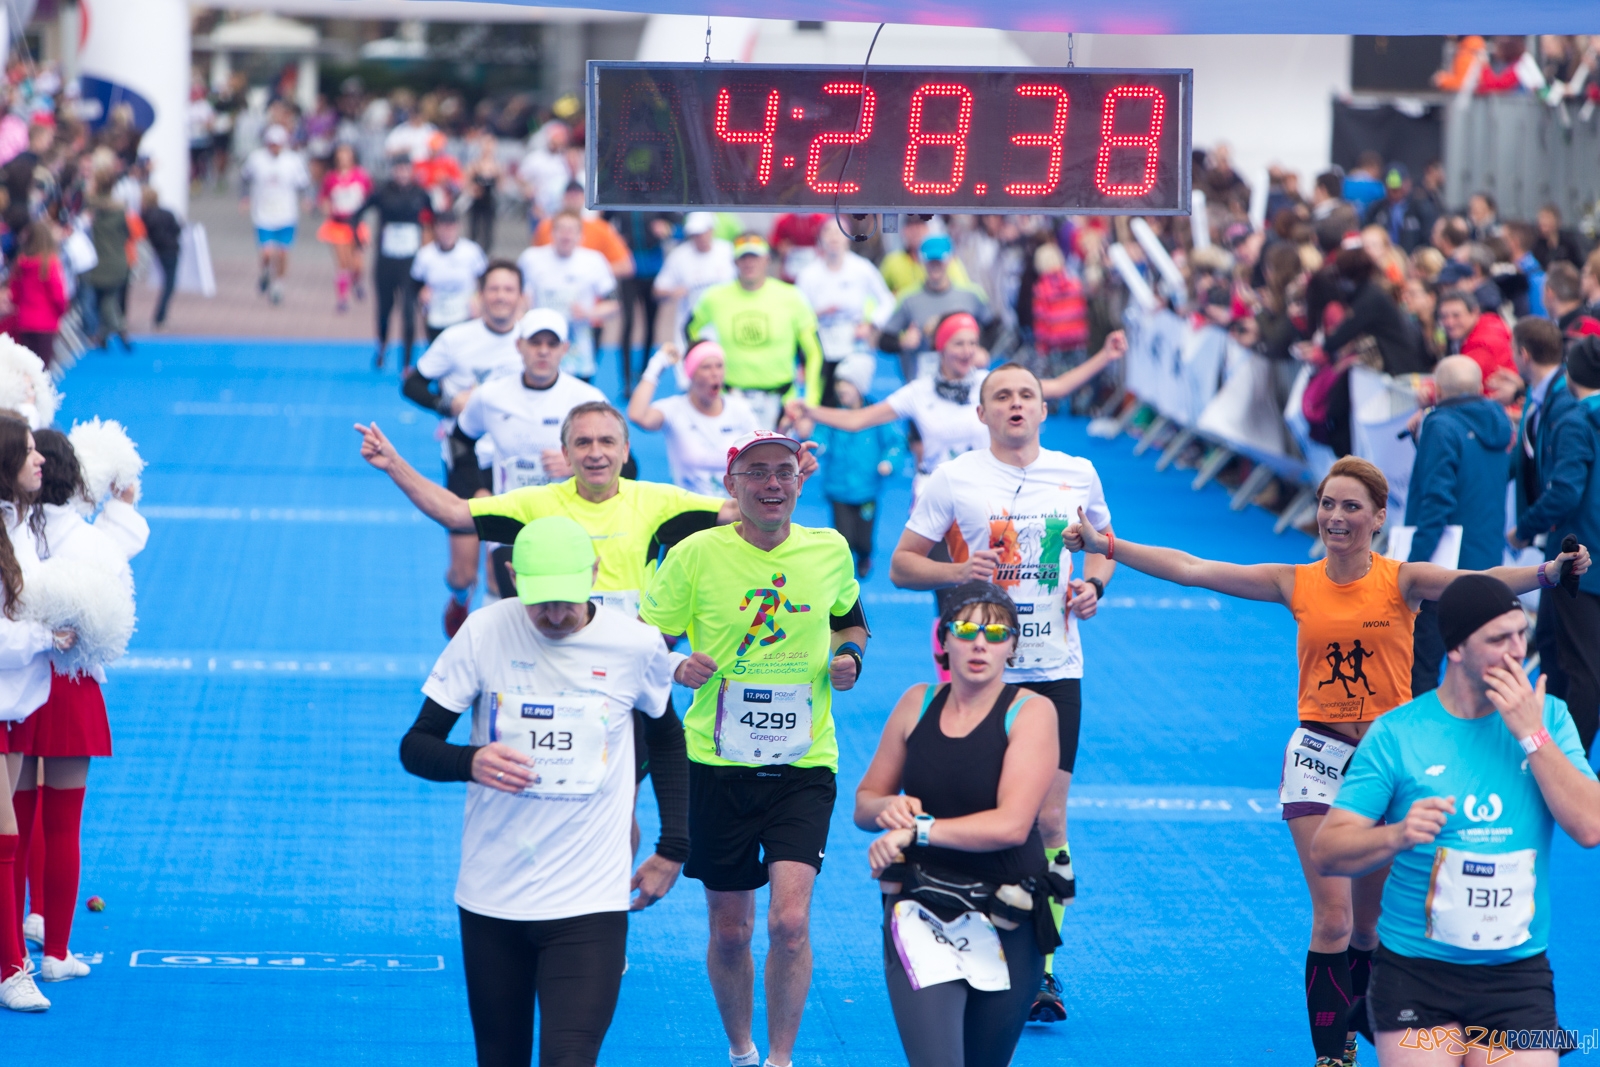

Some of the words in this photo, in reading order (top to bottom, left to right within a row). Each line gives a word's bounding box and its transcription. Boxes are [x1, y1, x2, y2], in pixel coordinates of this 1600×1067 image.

[713, 82, 1166, 197] 4:28.38
[996, 569, 1058, 580] Miasta
[1017, 621, 1051, 637] 614
[1362, 620, 1390, 628] IWONA
[763, 652, 809, 661] 11.09.2016
[732, 660, 750, 675] 5
[740, 711, 797, 730] 4299
[529, 730, 573, 751] 143
[749, 732, 788, 743] Grzegorz
[1294, 752, 1338, 780] 1486
[1303, 772, 1327, 785] Iwona
[1466, 887, 1513, 908] 1312
[1481, 914, 1498, 923] Jan
